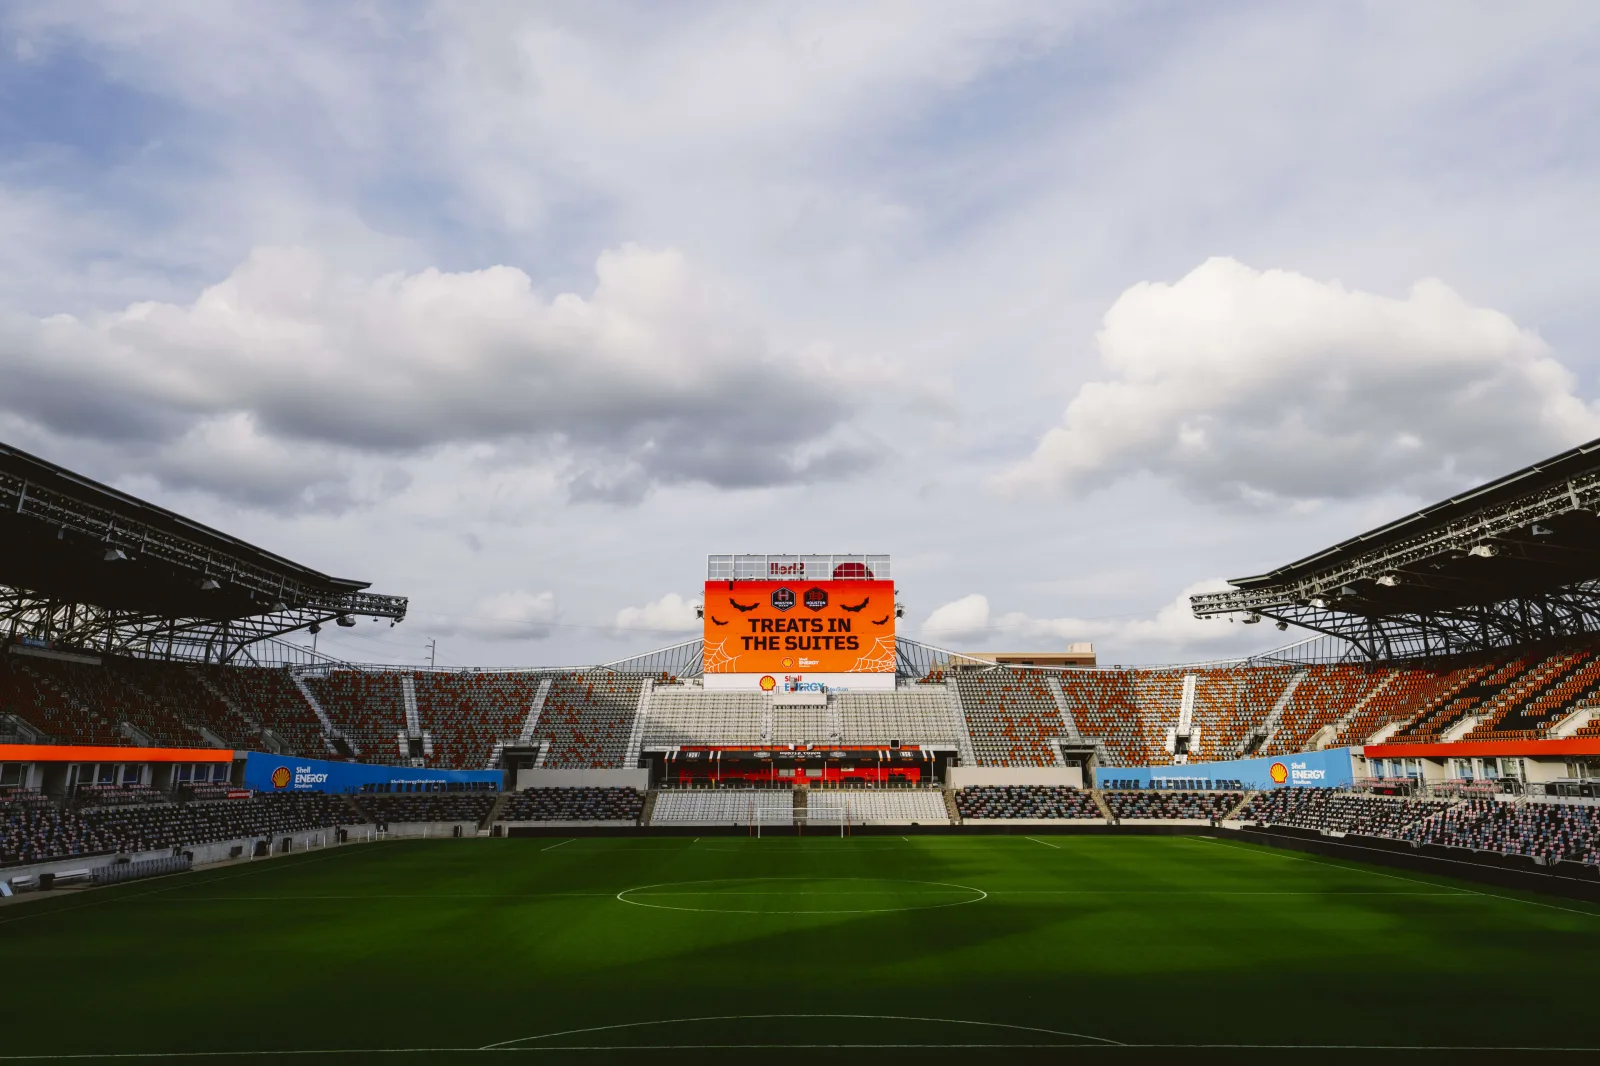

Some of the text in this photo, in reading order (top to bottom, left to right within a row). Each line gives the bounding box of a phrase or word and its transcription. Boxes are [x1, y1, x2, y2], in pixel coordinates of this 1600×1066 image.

[748, 618, 851, 633] TREATS IN
[741, 636, 859, 650] THE SUITES
[1291, 762, 1306, 770] Shell
[294, 774, 328, 783] ENERGY
[1291, 769, 1325, 780] ENERGY
